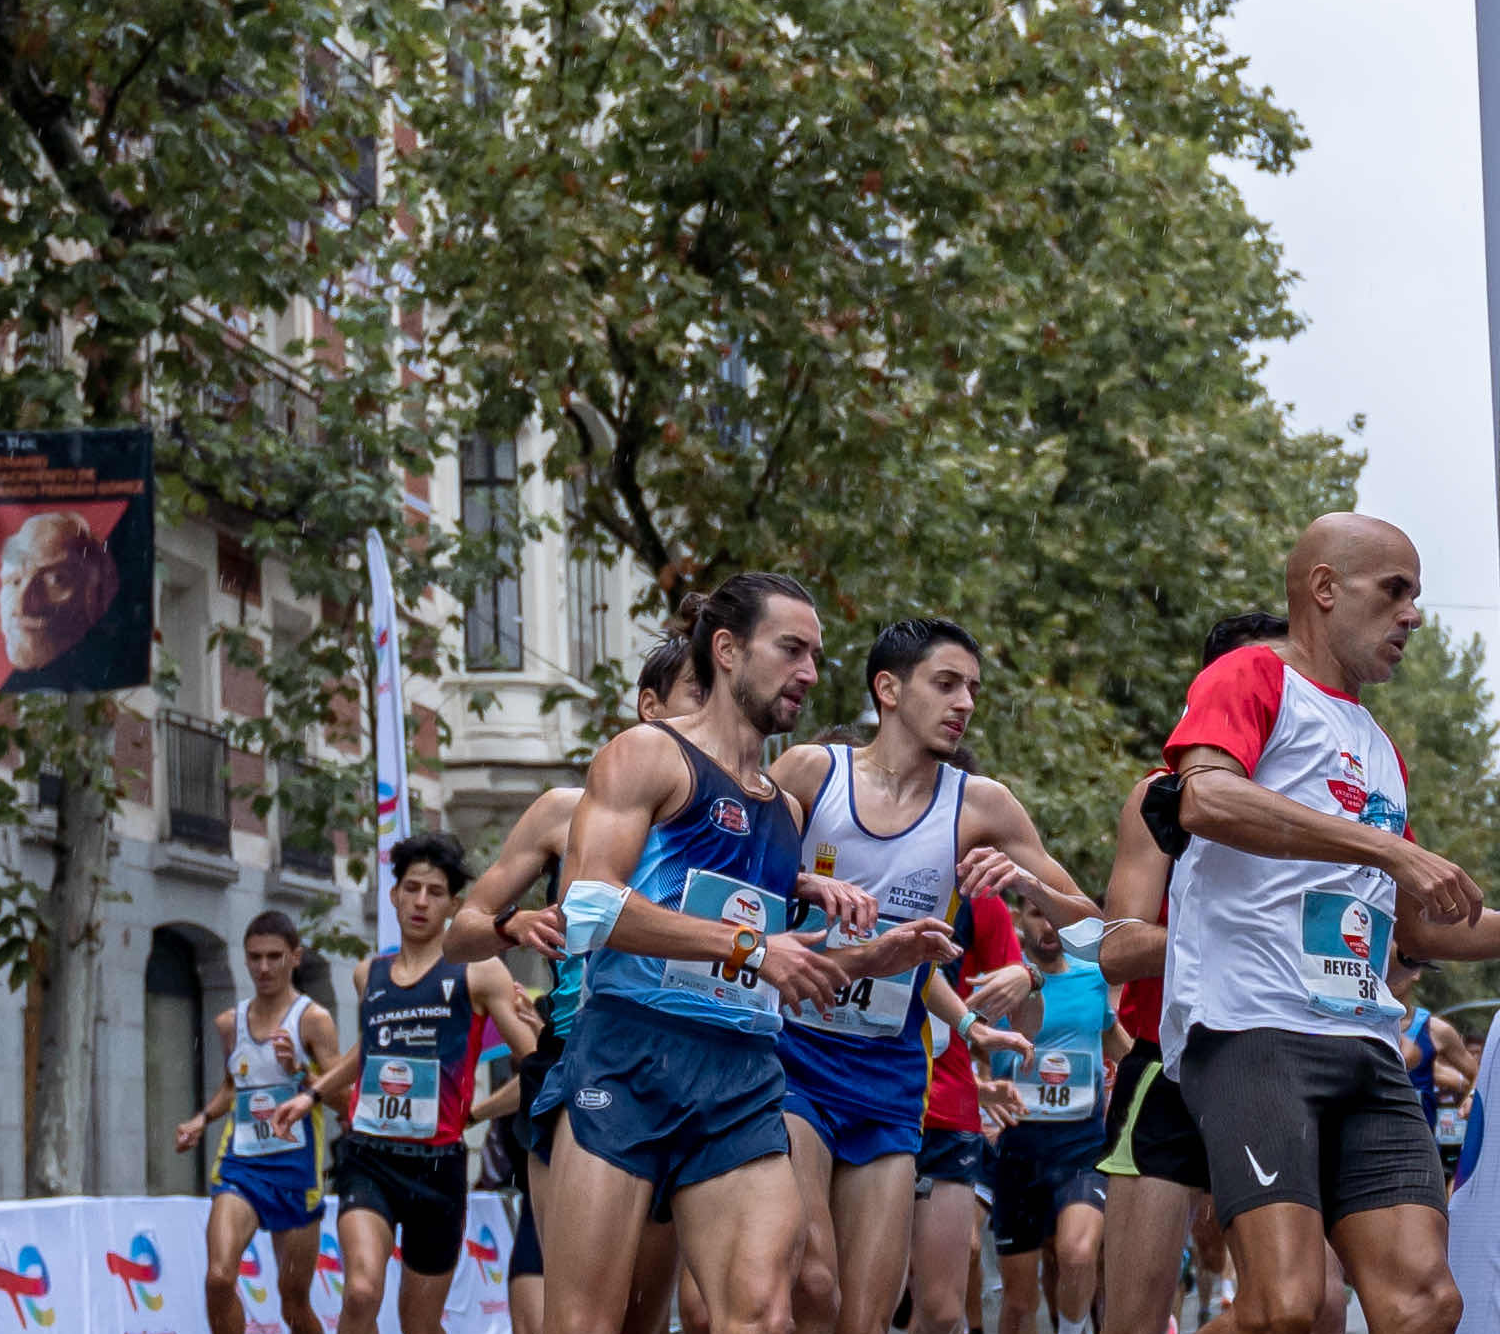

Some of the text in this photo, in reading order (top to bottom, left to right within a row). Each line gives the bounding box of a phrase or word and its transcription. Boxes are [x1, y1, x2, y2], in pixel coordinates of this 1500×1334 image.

[1323, 959, 1362, 978] REYES
[1037, 1085, 1071, 1107] 148
[377, 1095, 412, 1121] 104
